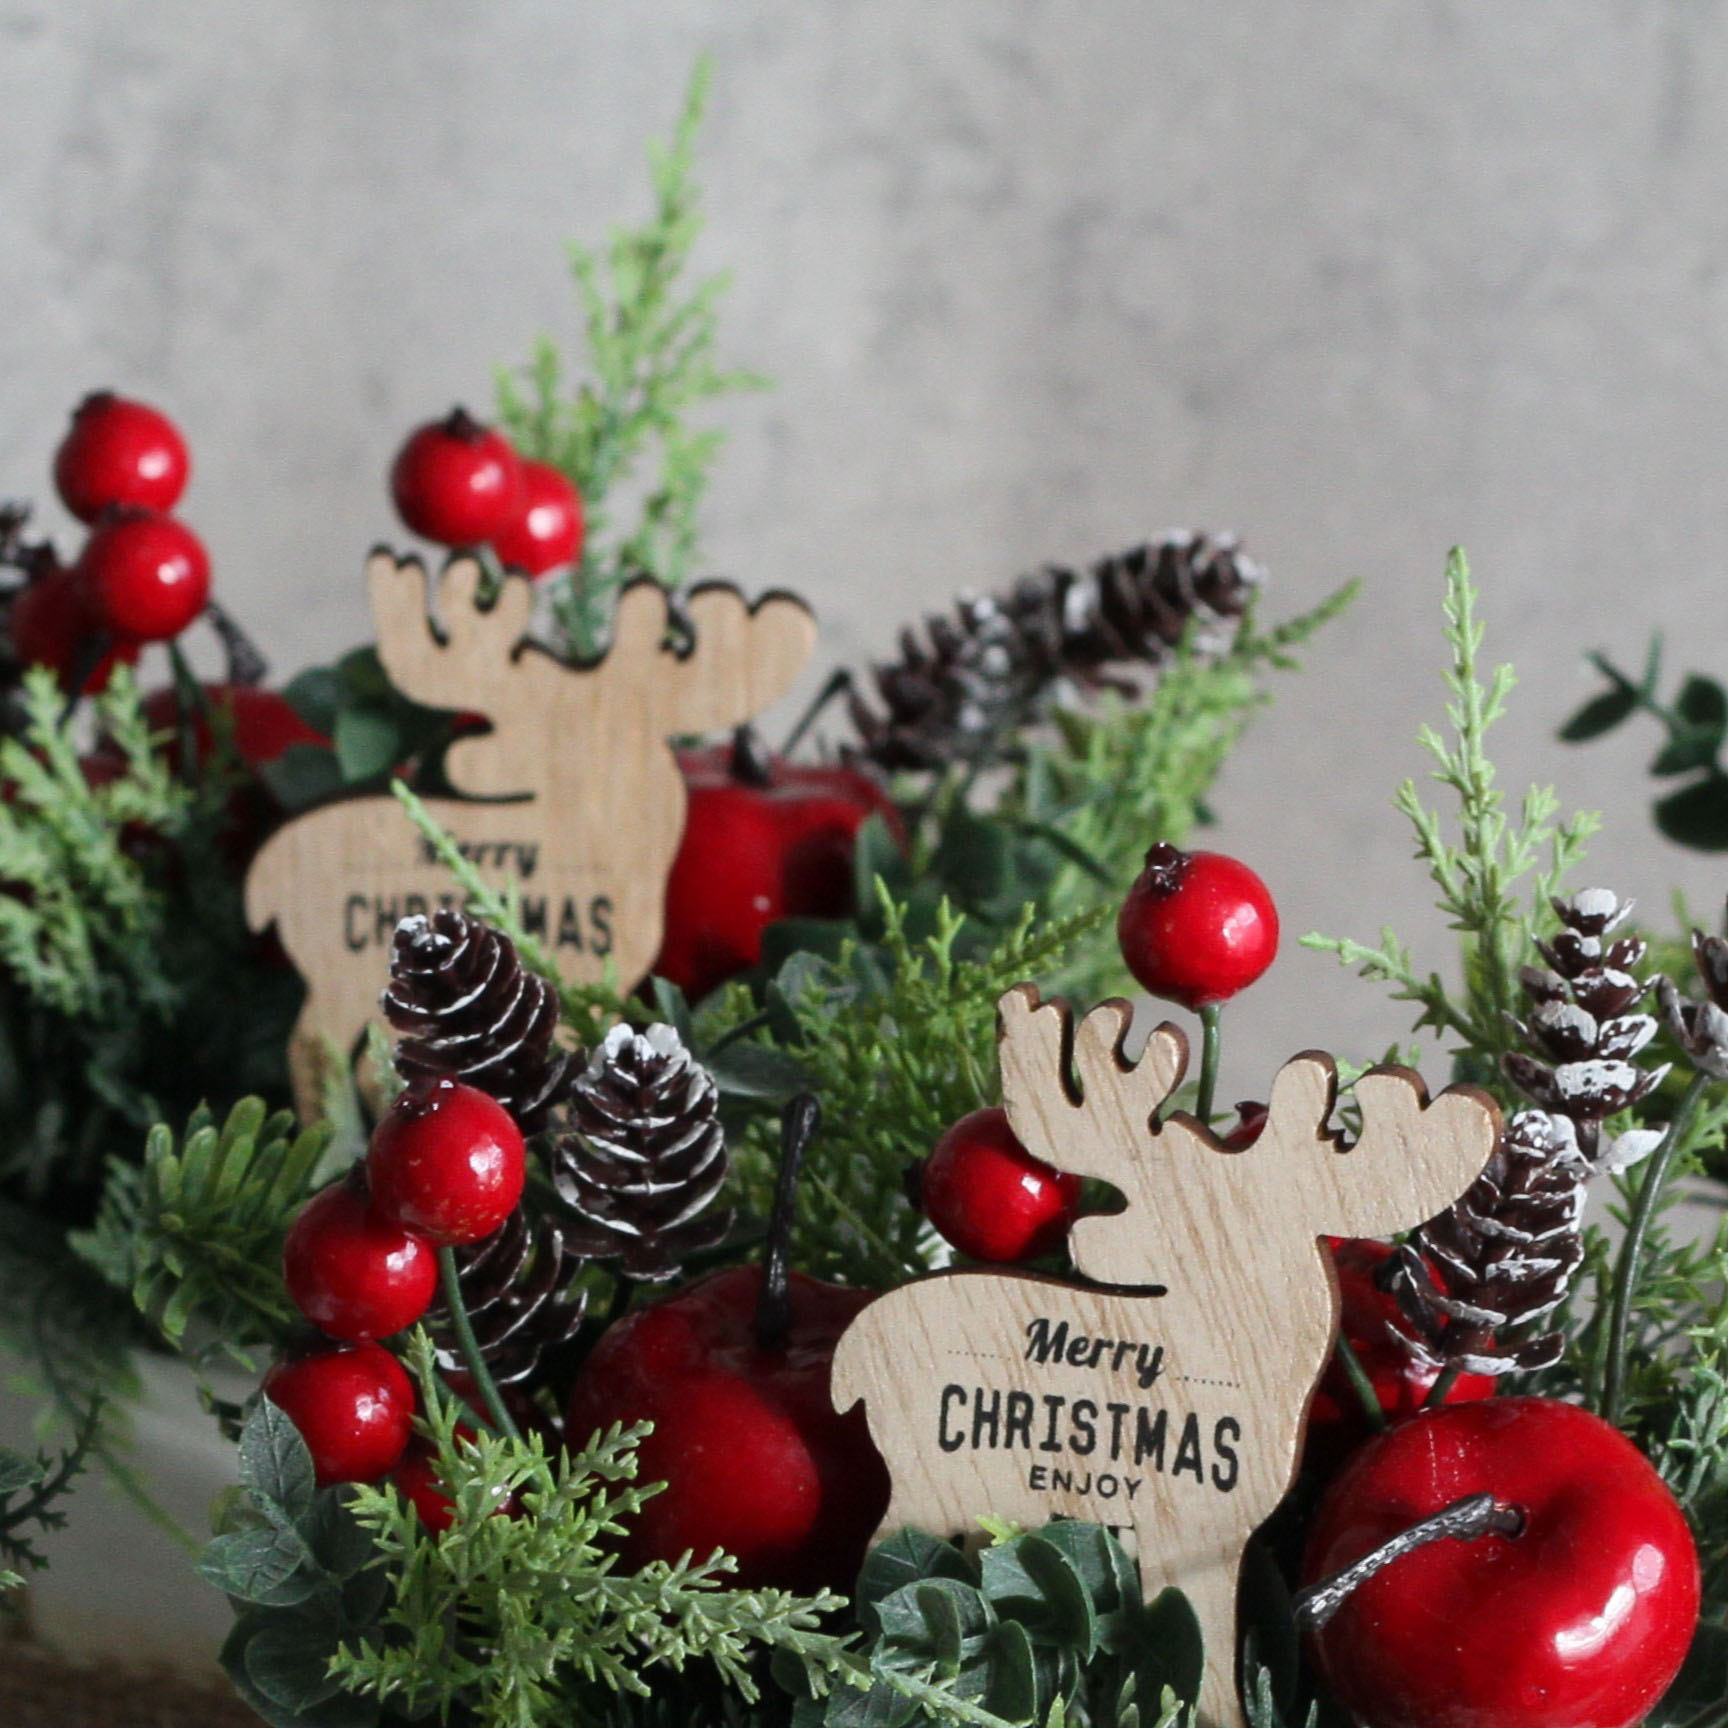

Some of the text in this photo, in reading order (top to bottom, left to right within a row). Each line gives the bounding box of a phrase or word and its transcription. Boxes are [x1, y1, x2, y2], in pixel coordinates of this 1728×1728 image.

[1025, 1317, 1165, 1389] Merry
[938, 1384, 1242, 1492] CHRISTMAS
[1029, 1464, 1143, 1500] ENJOY
